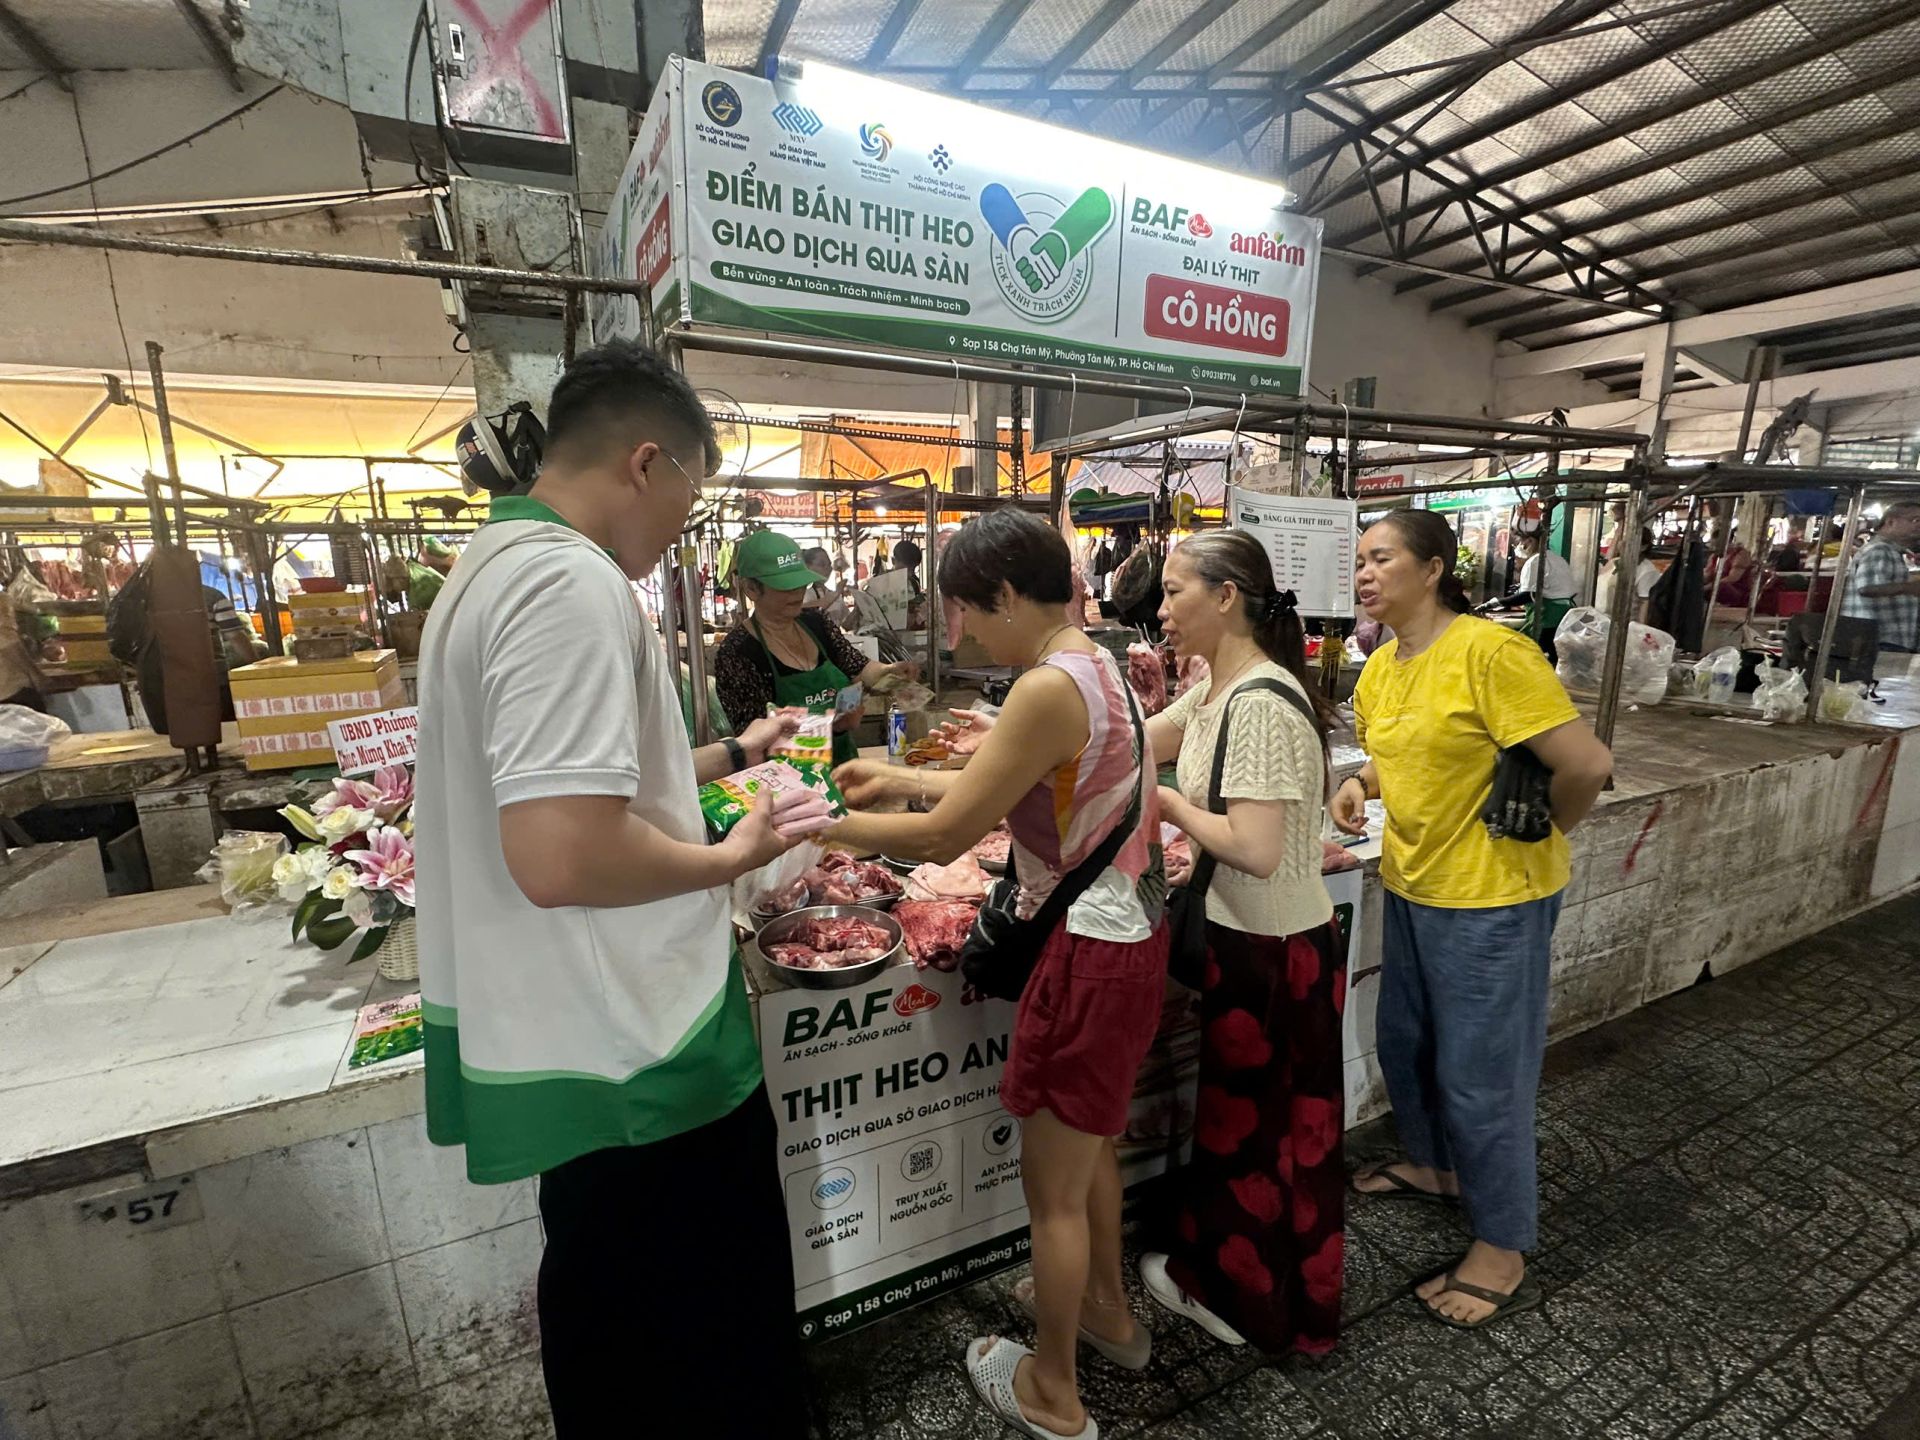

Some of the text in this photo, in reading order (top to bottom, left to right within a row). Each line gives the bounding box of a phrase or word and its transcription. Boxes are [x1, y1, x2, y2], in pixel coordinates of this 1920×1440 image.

[705, 125, 724, 137] CÔNG
[731, 142, 747, 151] MINH
[788, 145, 802, 155] GIAO
[813, 161, 826, 169] NAM
[924, 176, 939, 186] CÔNG
[954, 183, 966, 192] CAO
[706, 162, 974, 248] ĐIỂM BÁN THỊT HEO
[1130, 197, 1189, 232] BAF
[1130, 224, 1140, 233] ĂN
[1141, 228, 1158, 239] SẠCH
[1162, 231, 1179, 243] SỐNG
[640, 219, 667, 280] CÔ HỒNG
[712, 219, 969, 285] GIAO DỊCH QUA SÀN
[1230, 231, 1305, 267] anfarm
[995, 253, 1085, 312] TICK XANH TRÁCH NHIỆM
[1183, 256, 1260, 287] ĐẠI LÝ THỊT
[722, 265, 744, 279] Bền
[748, 271, 776, 286] vững
[787, 276, 801, 288] An
[804, 279, 829, 292] toàn
[839, 284, 867, 298] Trách
[871, 289, 901, 304] nhiệm
[910, 295, 934, 308] Minh
[937, 299, 961, 312] bạch
[1162, 289, 1277, 341] CÔ HỒNG
[963, 337, 980, 351] Sạp
[983, 340, 998, 351] 158
[1001, 342, 1019, 355] Chợ
[1021, 344, 1036, 356] Tân
[1055, 350, 1086, 366] Phường
[1087, 353, 1102, 364] Tân
[1118, 357, 1129, 368] TP.
[1130, 357, 1141, 369] Hồ
[1142, 360, 1155, 372] Chí
[1156, 362, 1175, 374] Minh
[1260, 376, 1281, 388] baf.vn
[1298, 517, 1316, 527] THỊT
[1318, 518, 1333, 526] HEO
[777, 552, 797, 566] BAF
[805, 689, 828, 704] BAF
[339, 720, 372, 742] UBND
[782, 988, 893, 1047] BAF
[784, 1050, 801, 1063] ĂN
[804, 1041, 838, 1058] SẠCH
[846, 1030, 880, 1046] SỐNG
[882, 1021, 913, 1038] KHỎE
[781, 1033, 1009, 1122] THỊT HEO AN
[784, 1136, 821, 1158] GIAO
[826, 1125, 860, 1147] DỊCH
[864, 1116, 893, 1134] QUA
[896, 1105, 914, 1124] SỞ
[917, 1098, 951, 1118] GIAO
[954, 1088, 984, 1108] DỊCH
[974, 1178, 999, 1193] THỰC
[981, 1166, 995, 1178] AN
[895, 1180, 948, 1207] TRUY XUẤT
[890, 1193, 954, 1223] NGUỒN GỐC
[805, 1211, 864, 1238] GIAO DỊCH
[811, 1226, 859, 1250] QUA SÀN
[824, 1308, 852, 1329] Sạp
[856, 1296, 880, 1316] 158
[884, 1284, 913, 1304] Chợ
[914, 1275, 938, 1293] Tân
[941, 1264, 964, 1282] Mỹ,
[966, 1246, 1013, 1271] Phường
